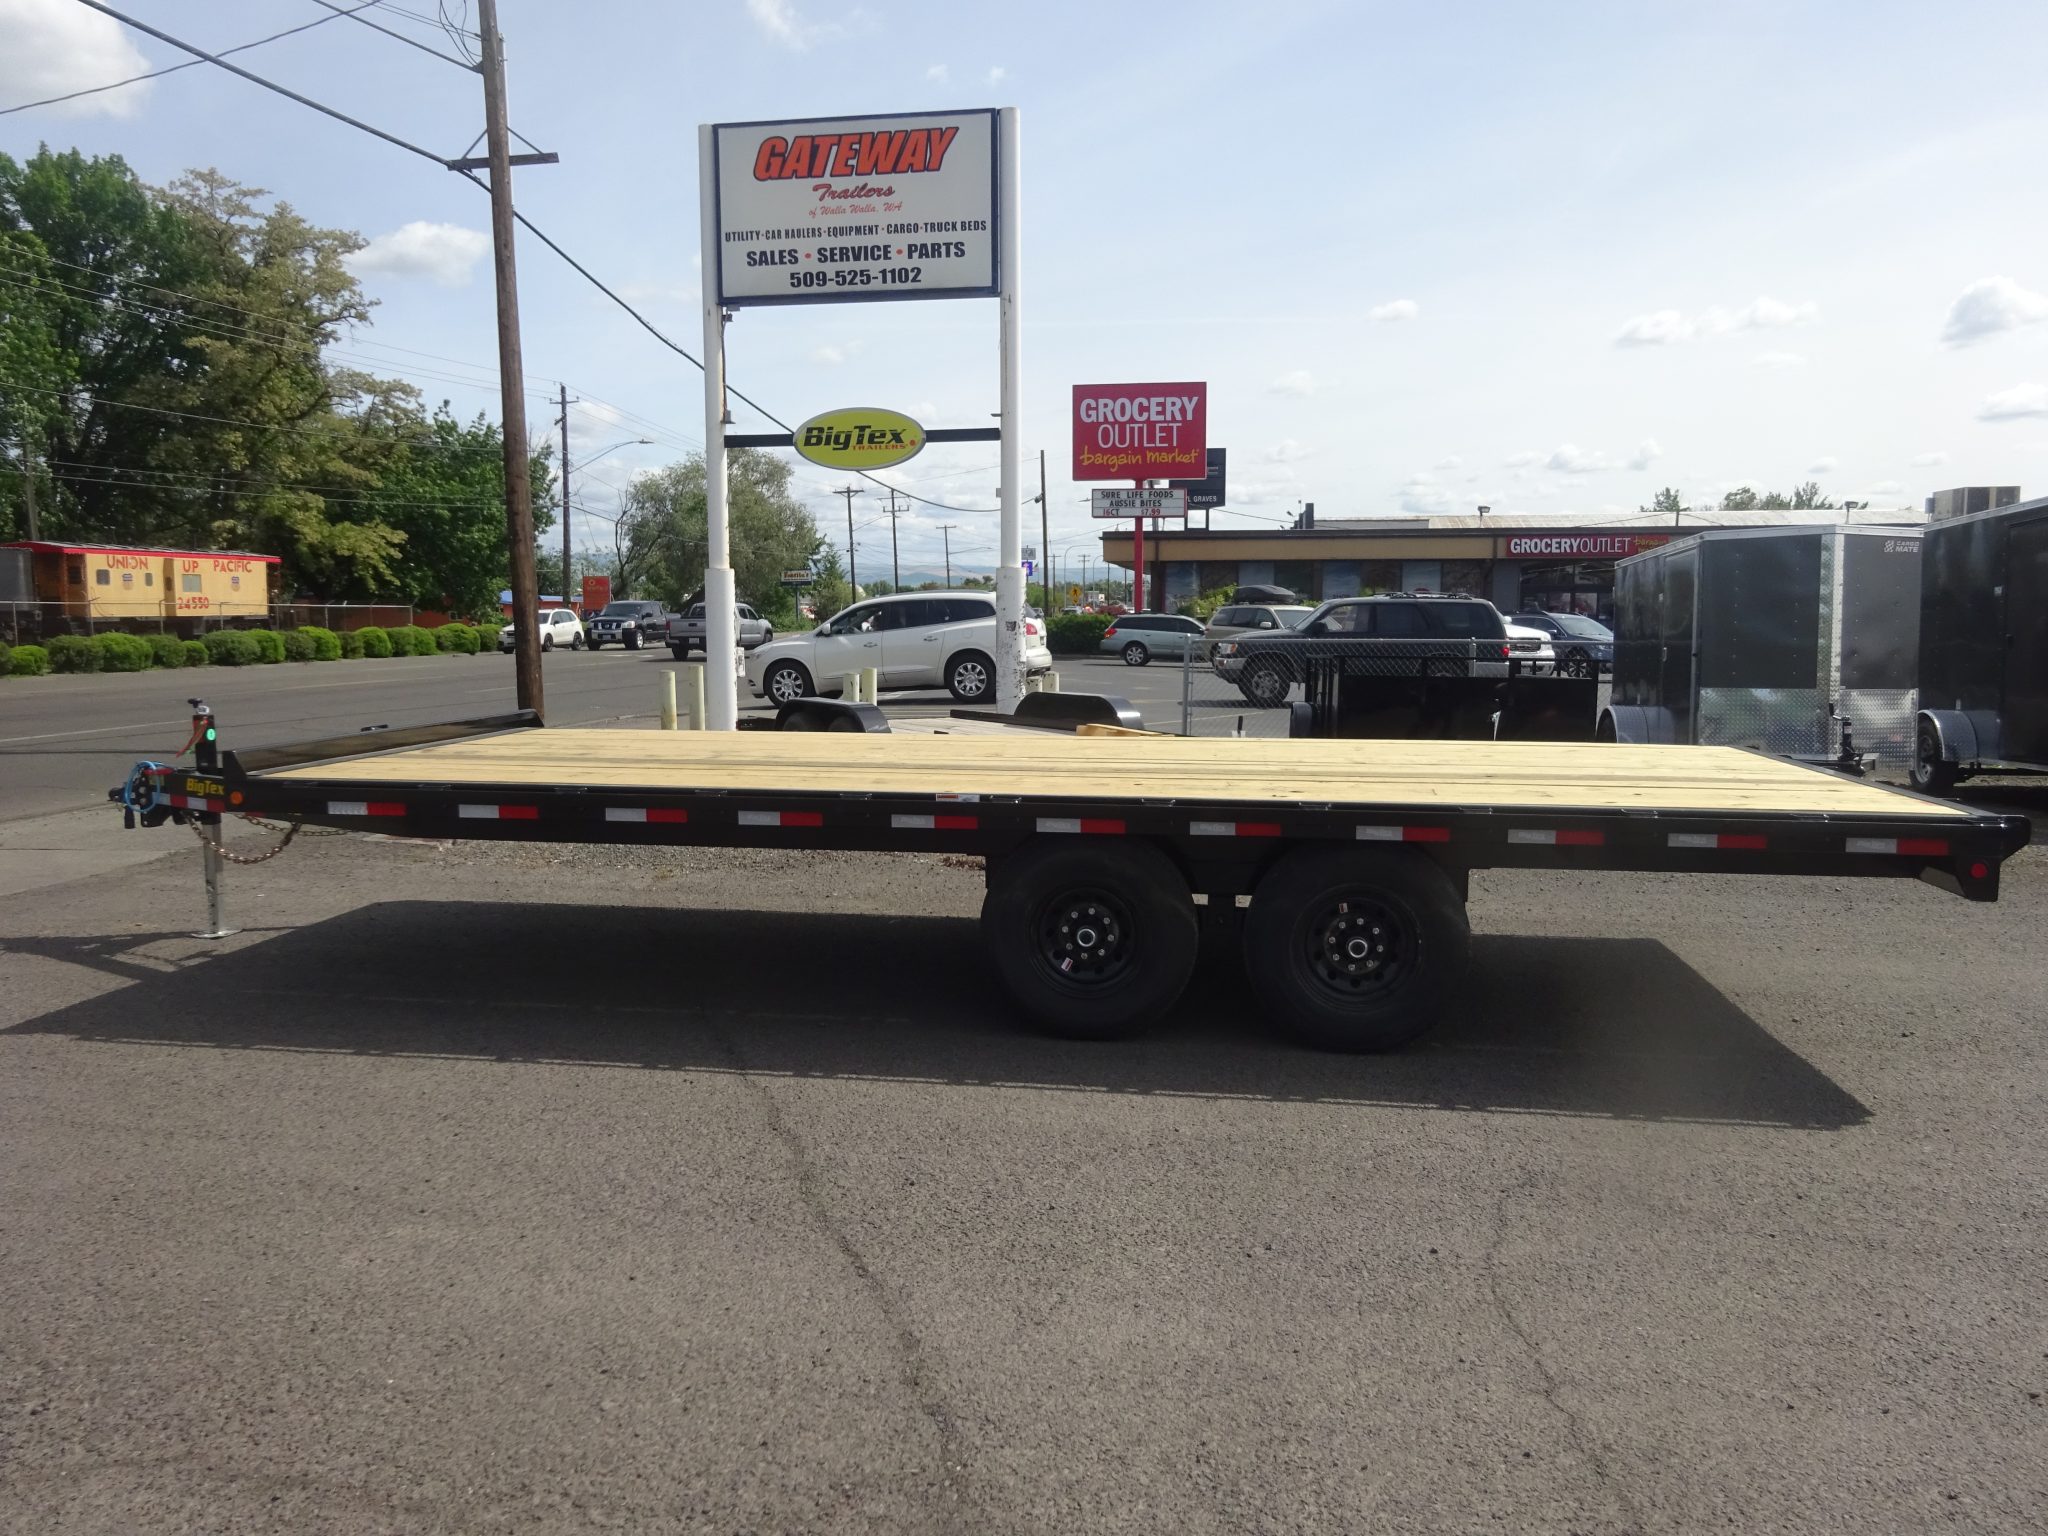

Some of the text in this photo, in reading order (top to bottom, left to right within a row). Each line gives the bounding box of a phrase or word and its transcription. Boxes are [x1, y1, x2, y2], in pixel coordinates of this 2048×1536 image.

[753, 126, 959, 181] GATEWAY
[812, 182, 896, 201] Trailers
[808, 206, 818, 219] of
[820, 205, 847, 216] Walla
[883, 201, 903, 212] WA
[725, 220, 987, 242] UTILITY CAR HAULERS EQUIPMENT CARGO TRUCK BEDS
[746, 241, 966, 267] SALES SERVICE PARTS
[789, 266, 922, 288] 509-525-1102
[1079, 396, 1199, 423] GROCERY
[803, 425, 907, 451] BigTex
[1097, 423, 1182, 448] OUTLET
[1080, 445, 1198, 472] bargain market
[1101, 491, 1121, 499] SURE
[1148, 490, 1174, 498] FOODS
[1103, 508, 1161, 516] 16CT $7.99
[106, 555, 253, 573] UNION UP PACIFIC
[186, 778, 225, 796] BigTex
